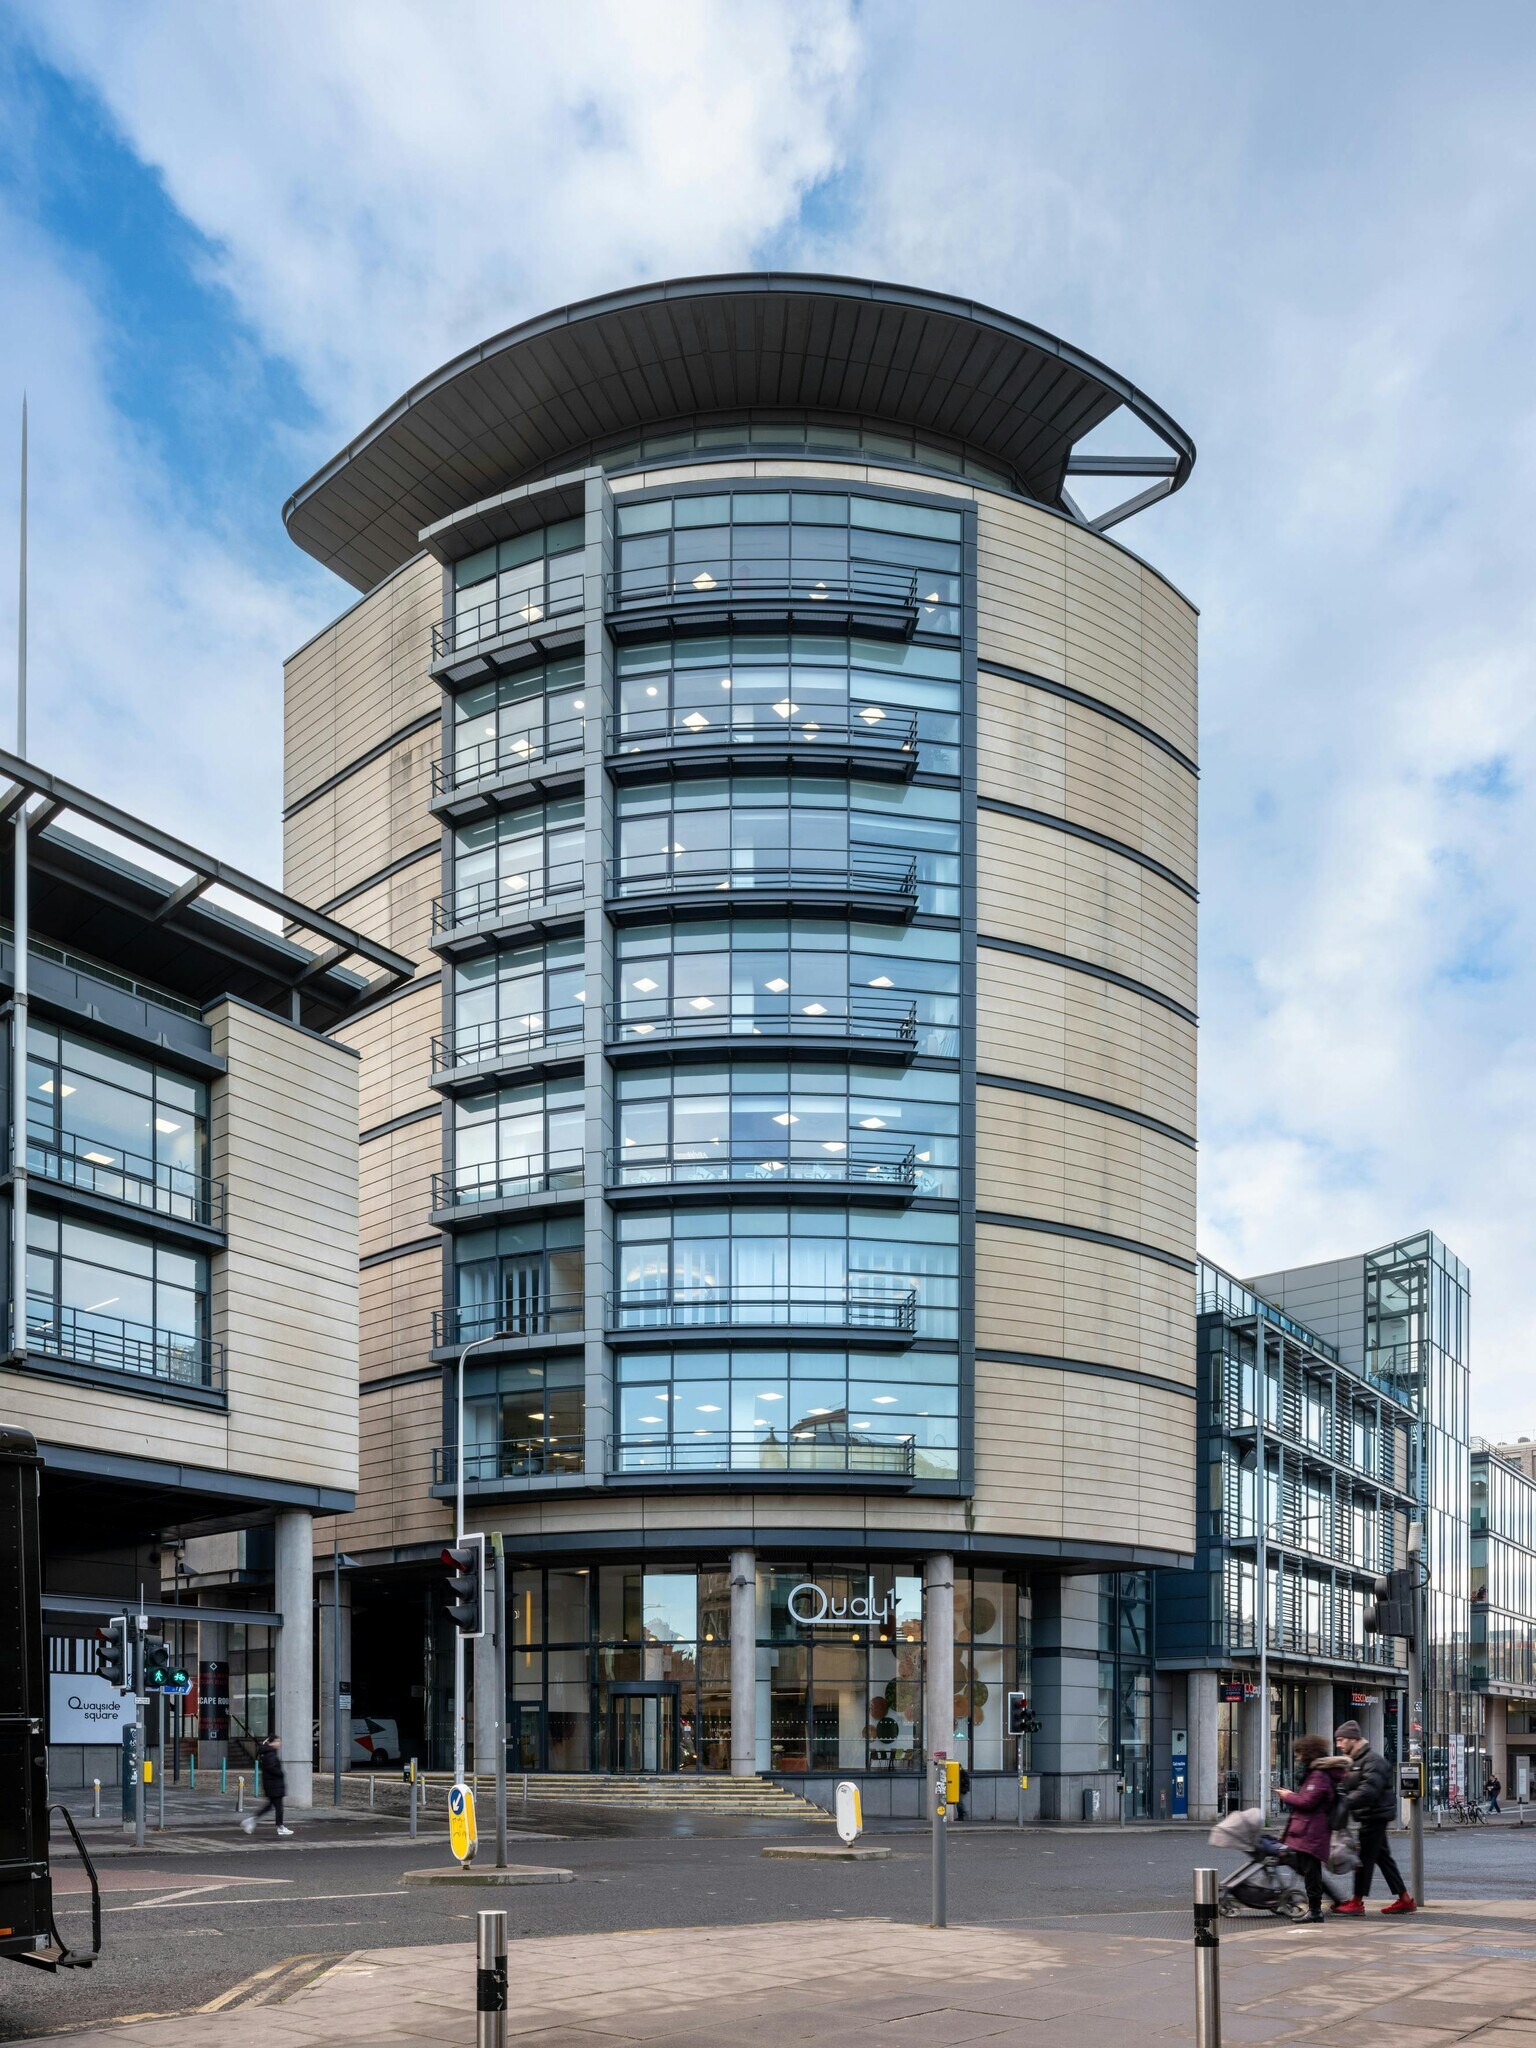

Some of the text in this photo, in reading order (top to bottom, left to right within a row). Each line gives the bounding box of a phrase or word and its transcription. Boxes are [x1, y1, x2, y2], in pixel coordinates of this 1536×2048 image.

[1352, 1694, 1366, 1702] TESCO
[68, 1696, 120, 1712] Quayside
[84, 1711, 119, 1722] square
